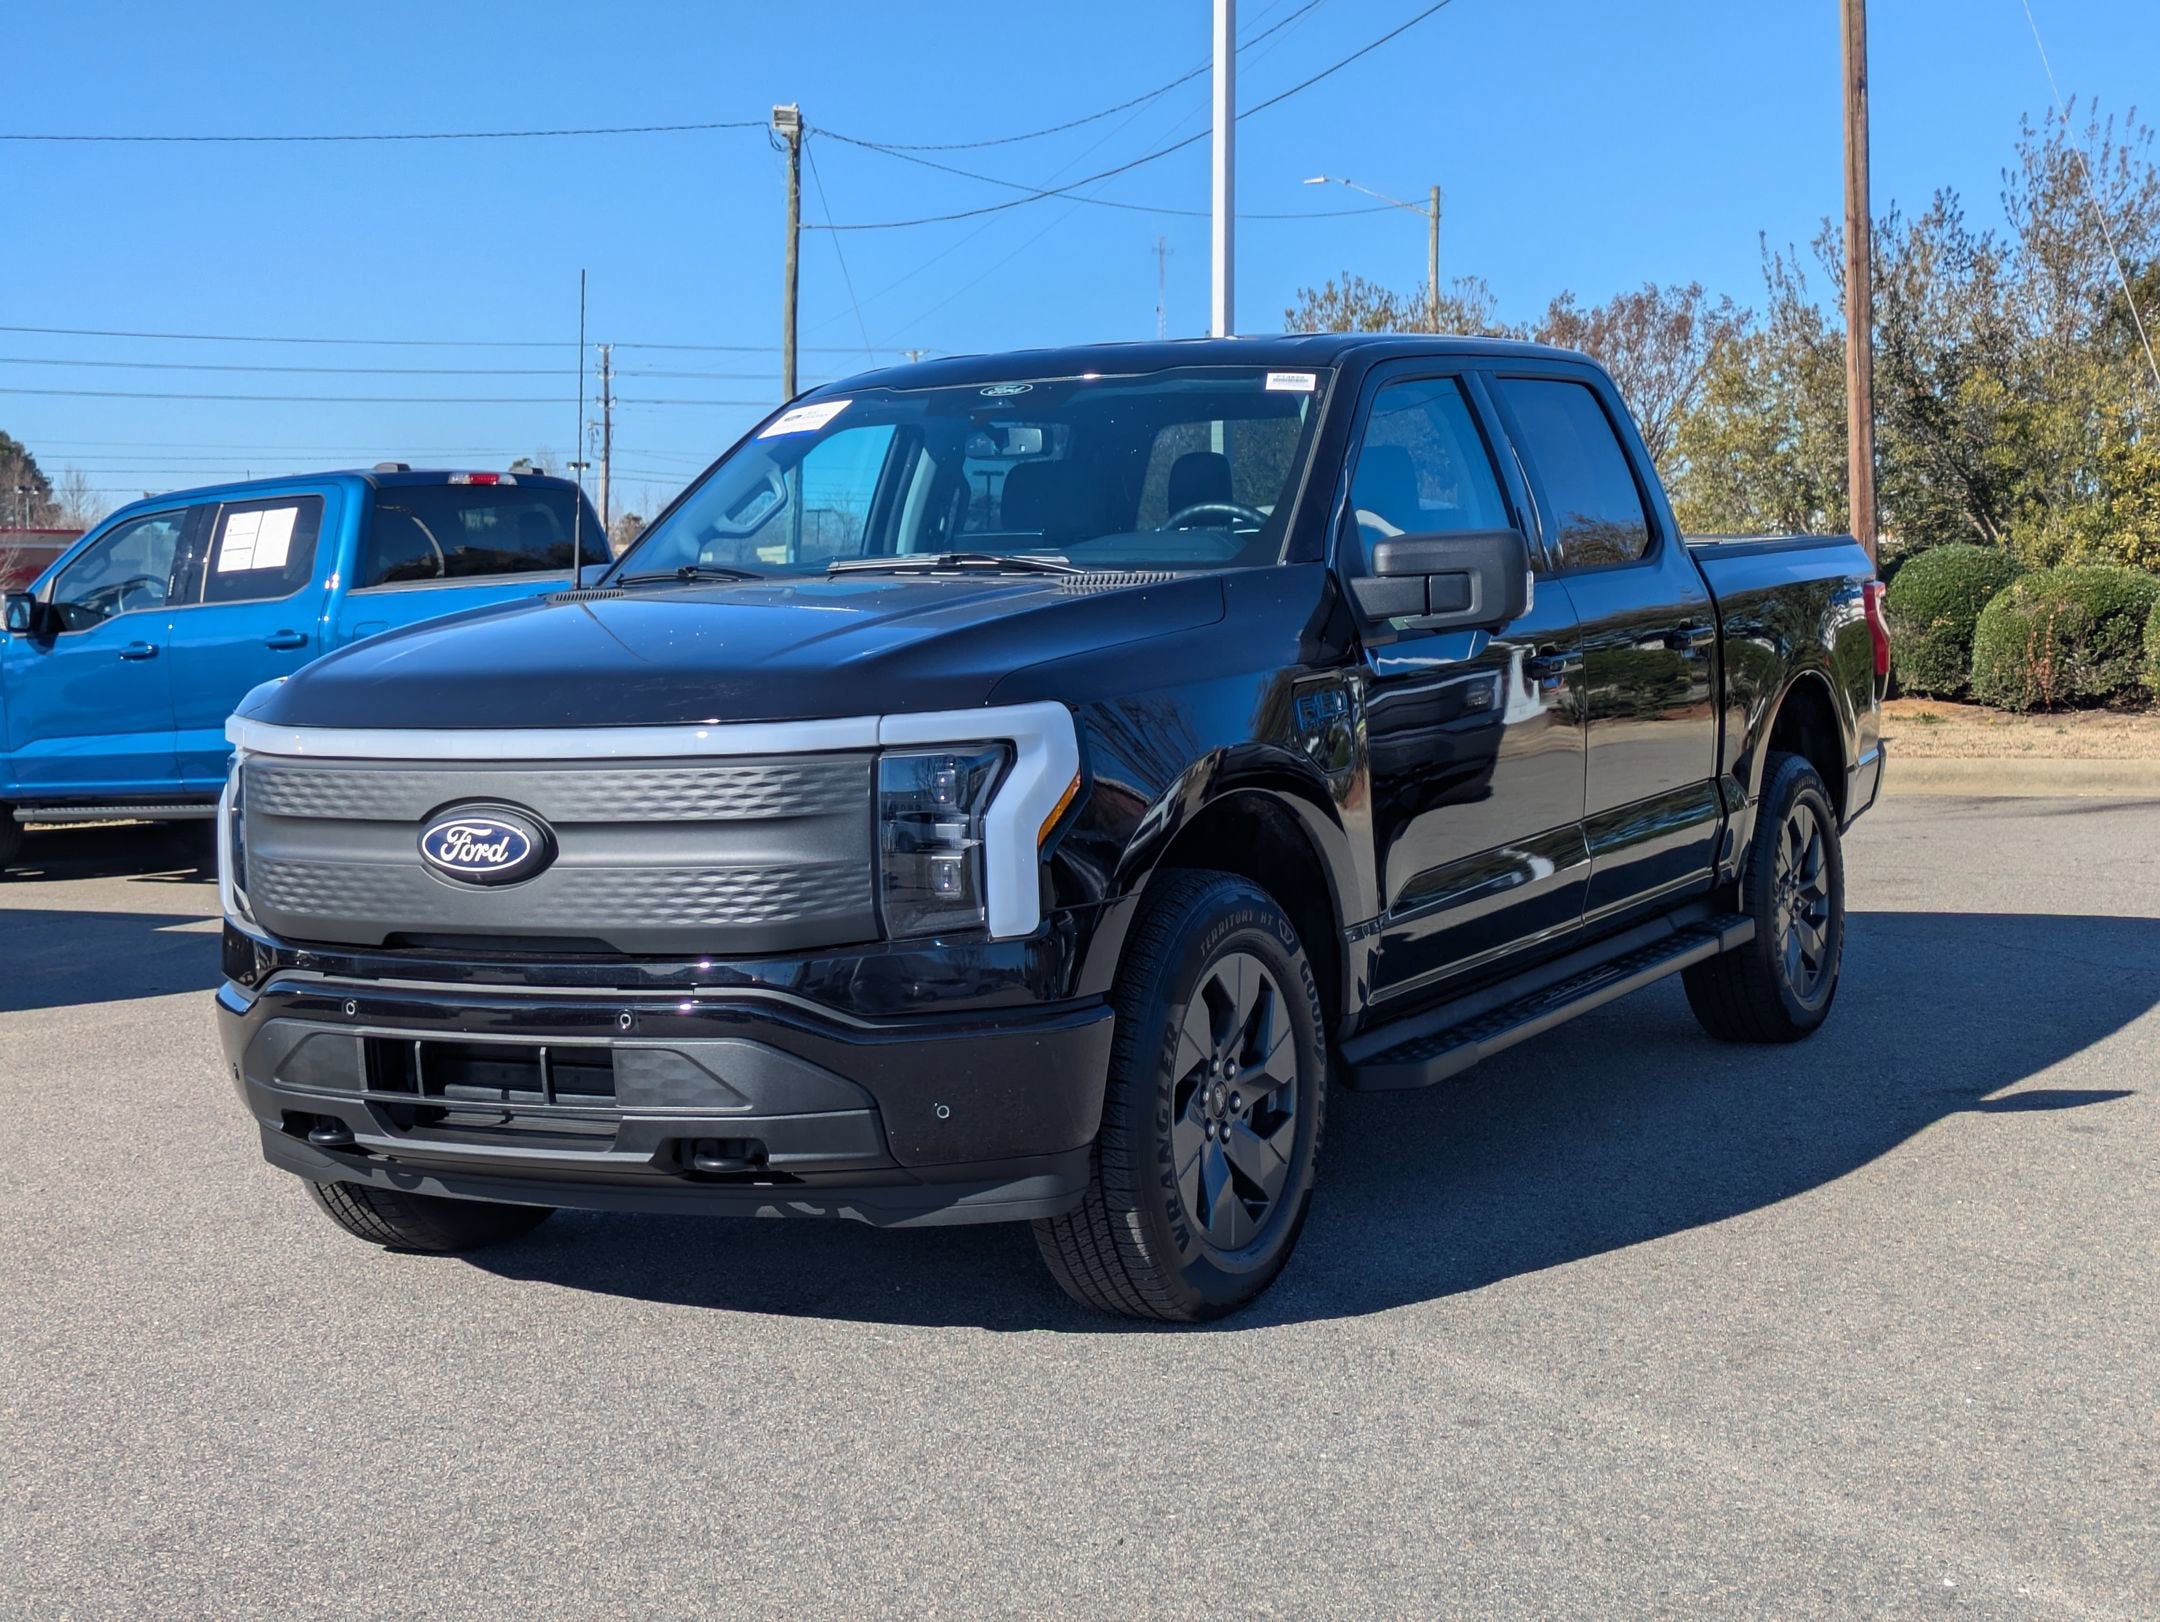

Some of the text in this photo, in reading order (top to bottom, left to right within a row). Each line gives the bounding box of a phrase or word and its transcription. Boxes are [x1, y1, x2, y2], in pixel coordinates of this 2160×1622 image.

[440, 826, 511, 863] Ford
[1200, 909, 1275, 957] TERRITORY HT
[1156, 1023, 1190, 1254] WRANGLER
